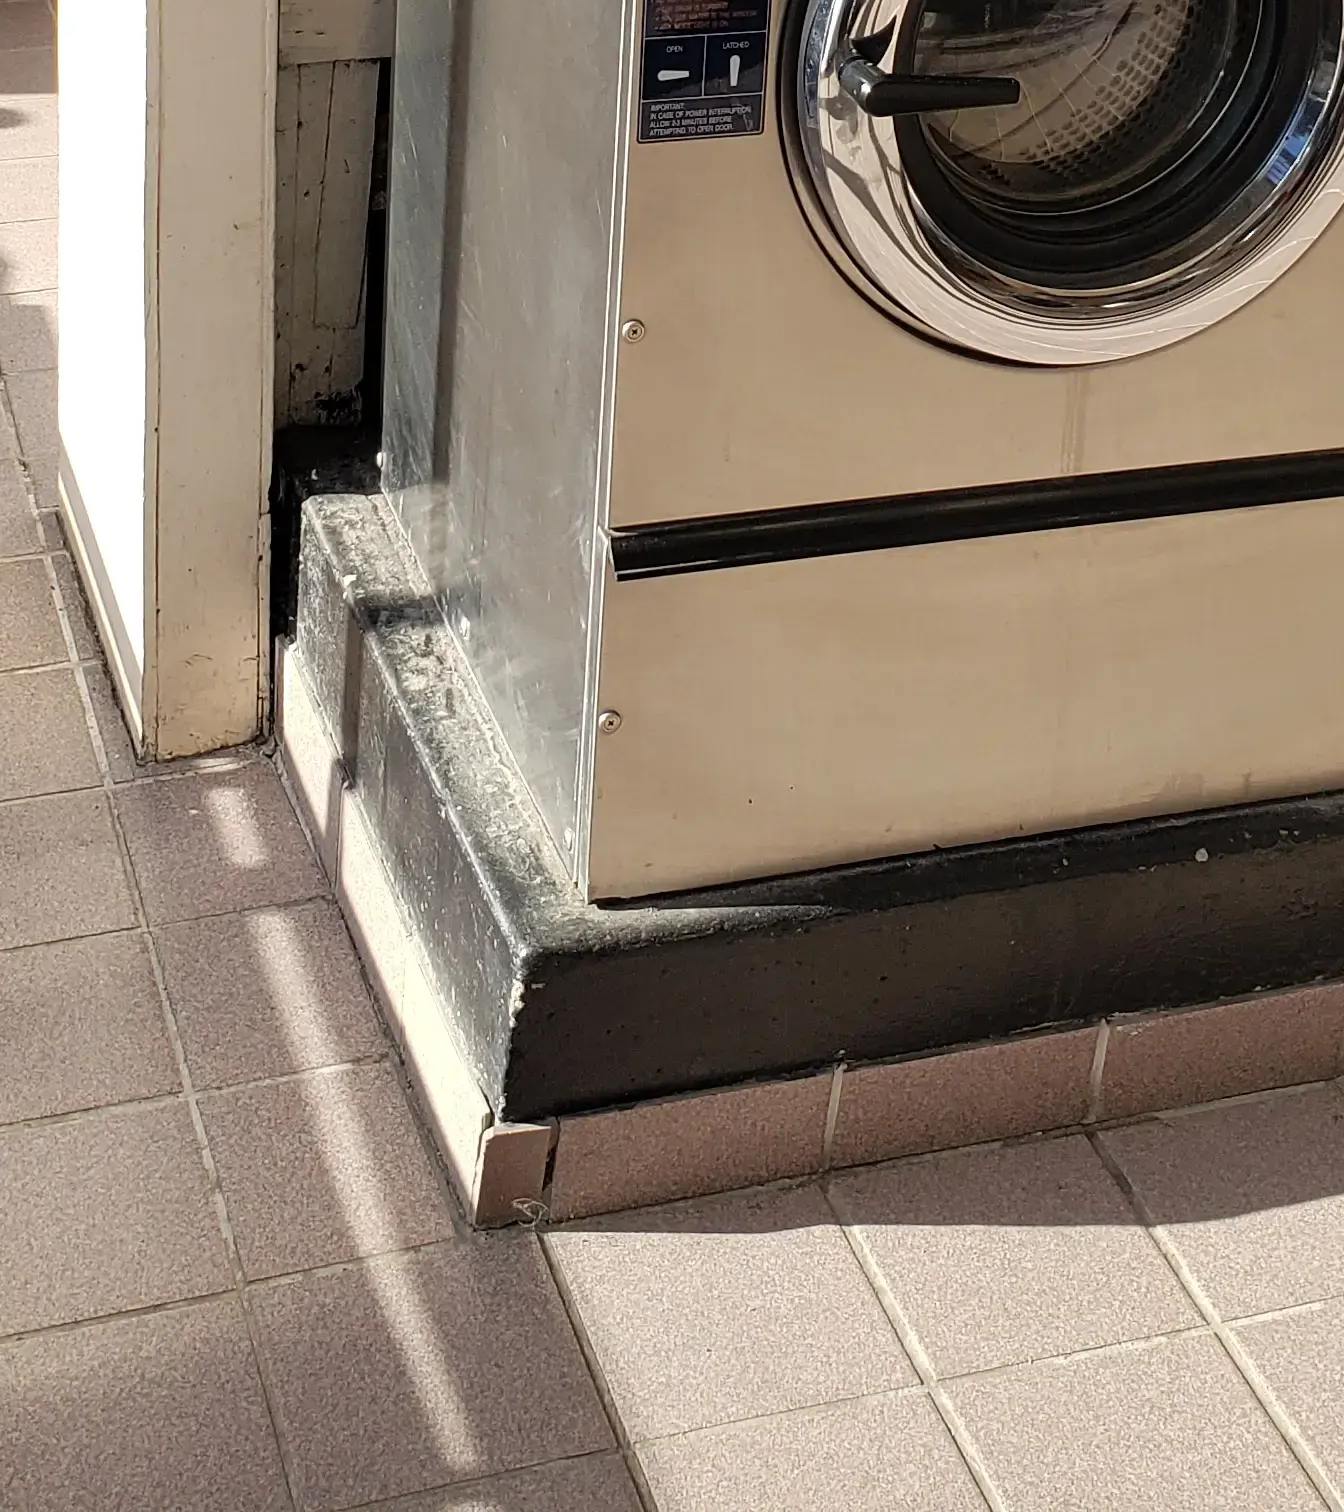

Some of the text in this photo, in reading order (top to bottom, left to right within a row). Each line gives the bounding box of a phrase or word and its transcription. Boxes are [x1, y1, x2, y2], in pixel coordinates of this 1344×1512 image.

[666, 45, 683, 53] OPEN
[722, 41, 750, 50] LATCHED
[658, 111, 674, 120] CASE
[675, 110, 684, 118] OF
[684, 109, 707, 118] POWER
[708, 115, 733, 124] BEFORE
[697, 125, 714, 133] OPEN
